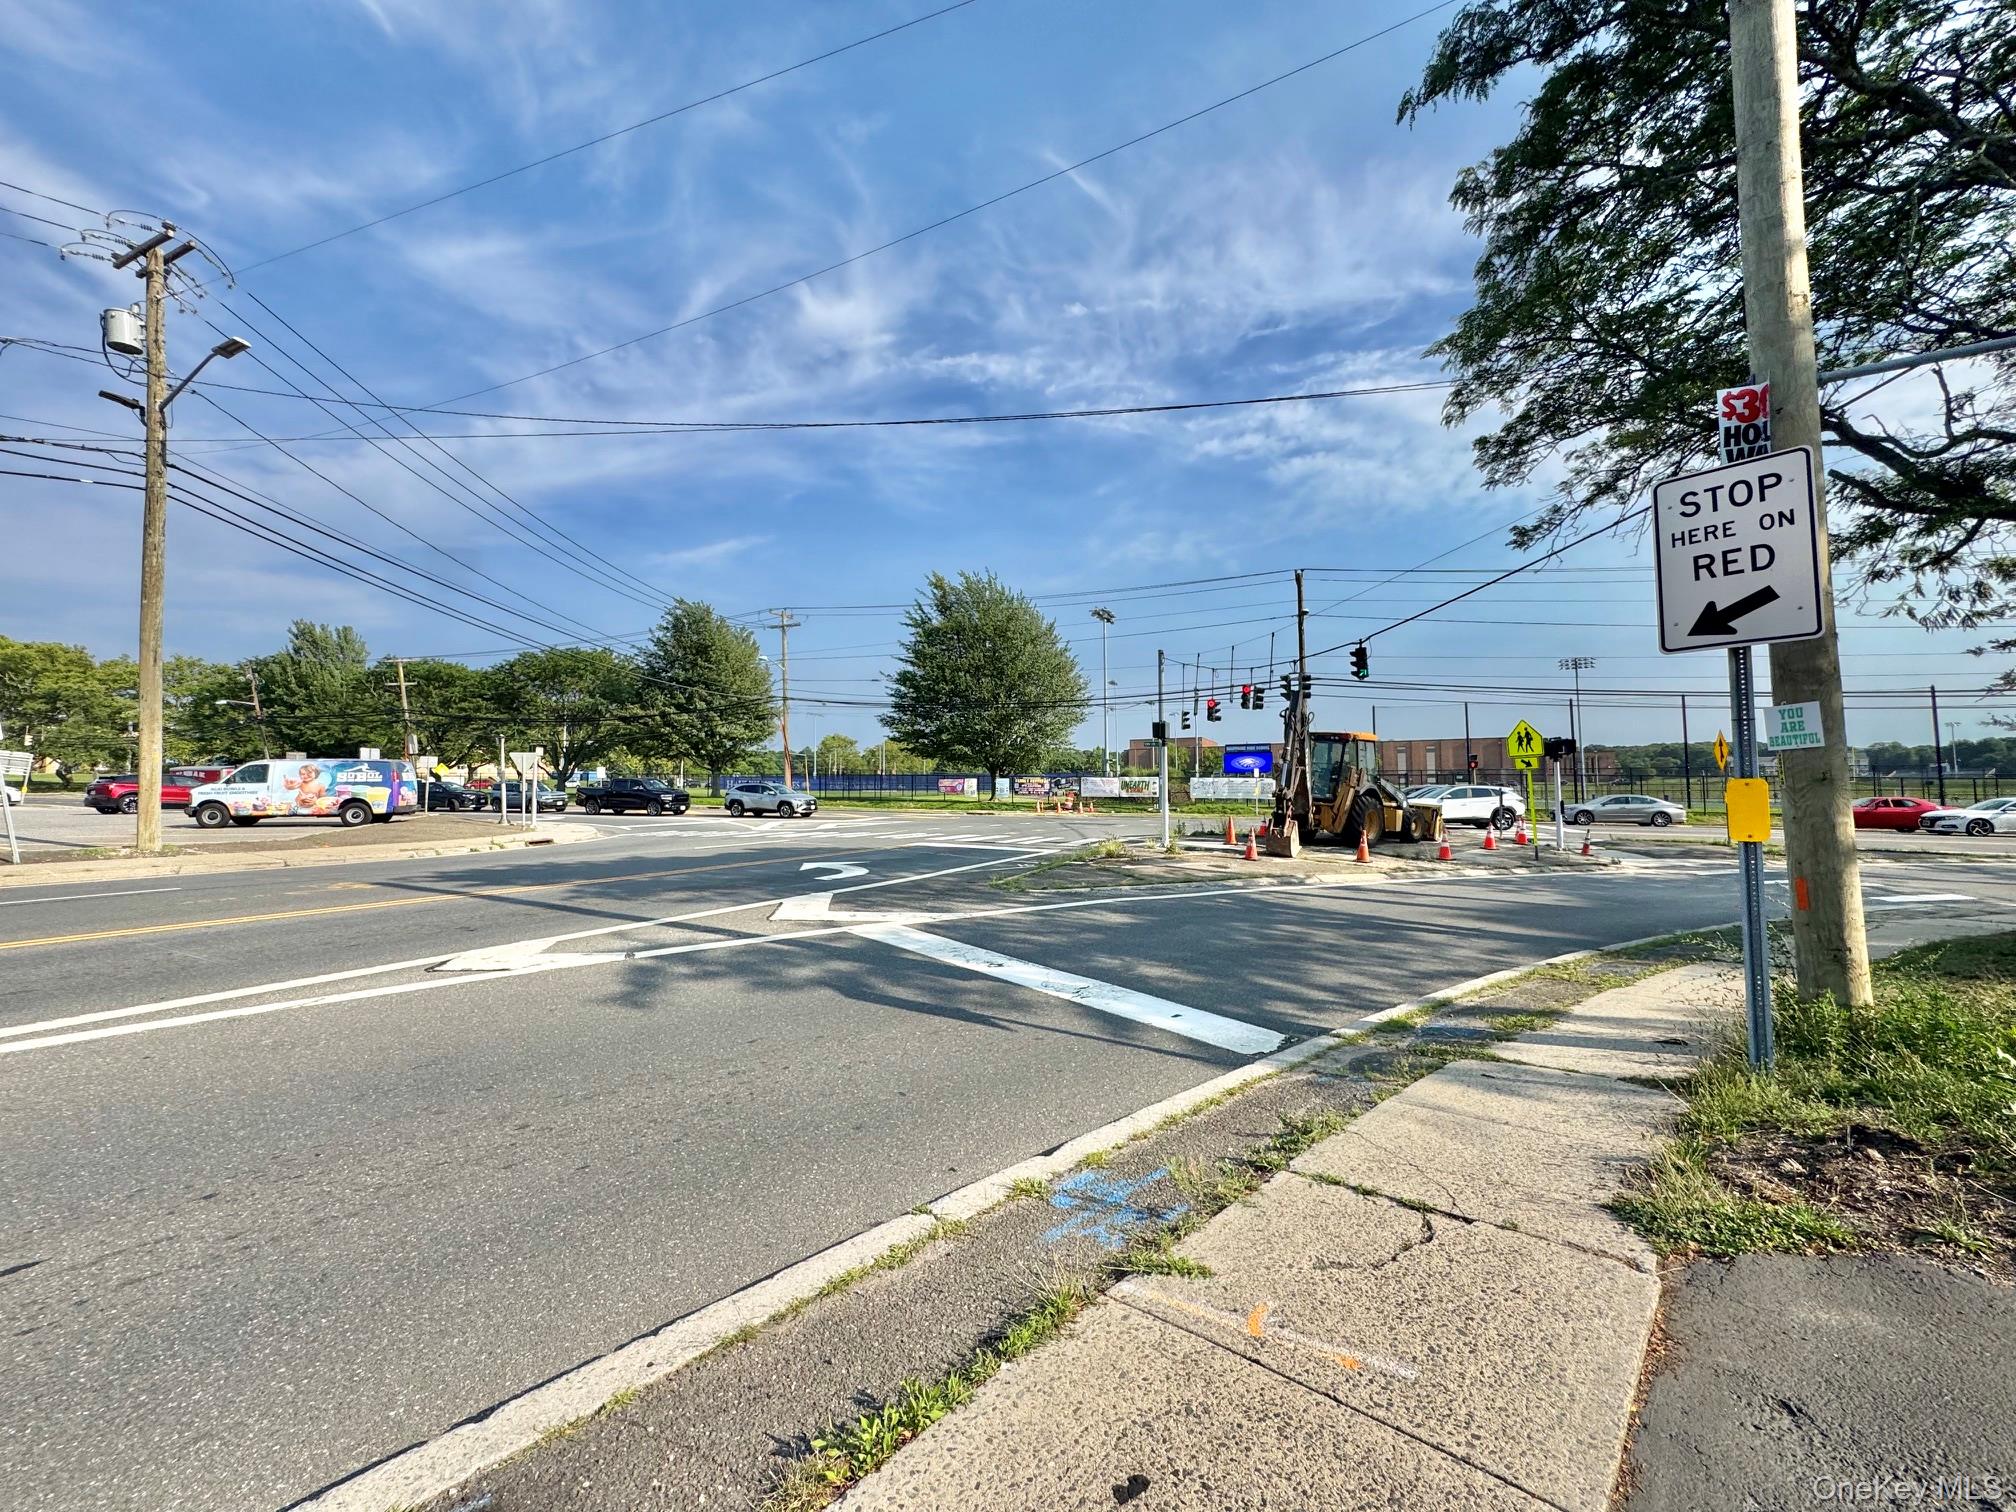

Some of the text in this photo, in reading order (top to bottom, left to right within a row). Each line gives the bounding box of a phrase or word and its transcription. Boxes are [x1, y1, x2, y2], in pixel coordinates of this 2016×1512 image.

[1679, 472, 1782, 518] STOP
[1671, 508, 1795, 549] HERE ON
[1692, 543, 1776, 582] RED
[1778, 707, 1804, 720] YOU
[1781, 720, 1806, 733] ARE
[1769, 732, 1821, 747] BEAUTIFUL
[1120, 780, 1150, 791] UNEARTH
